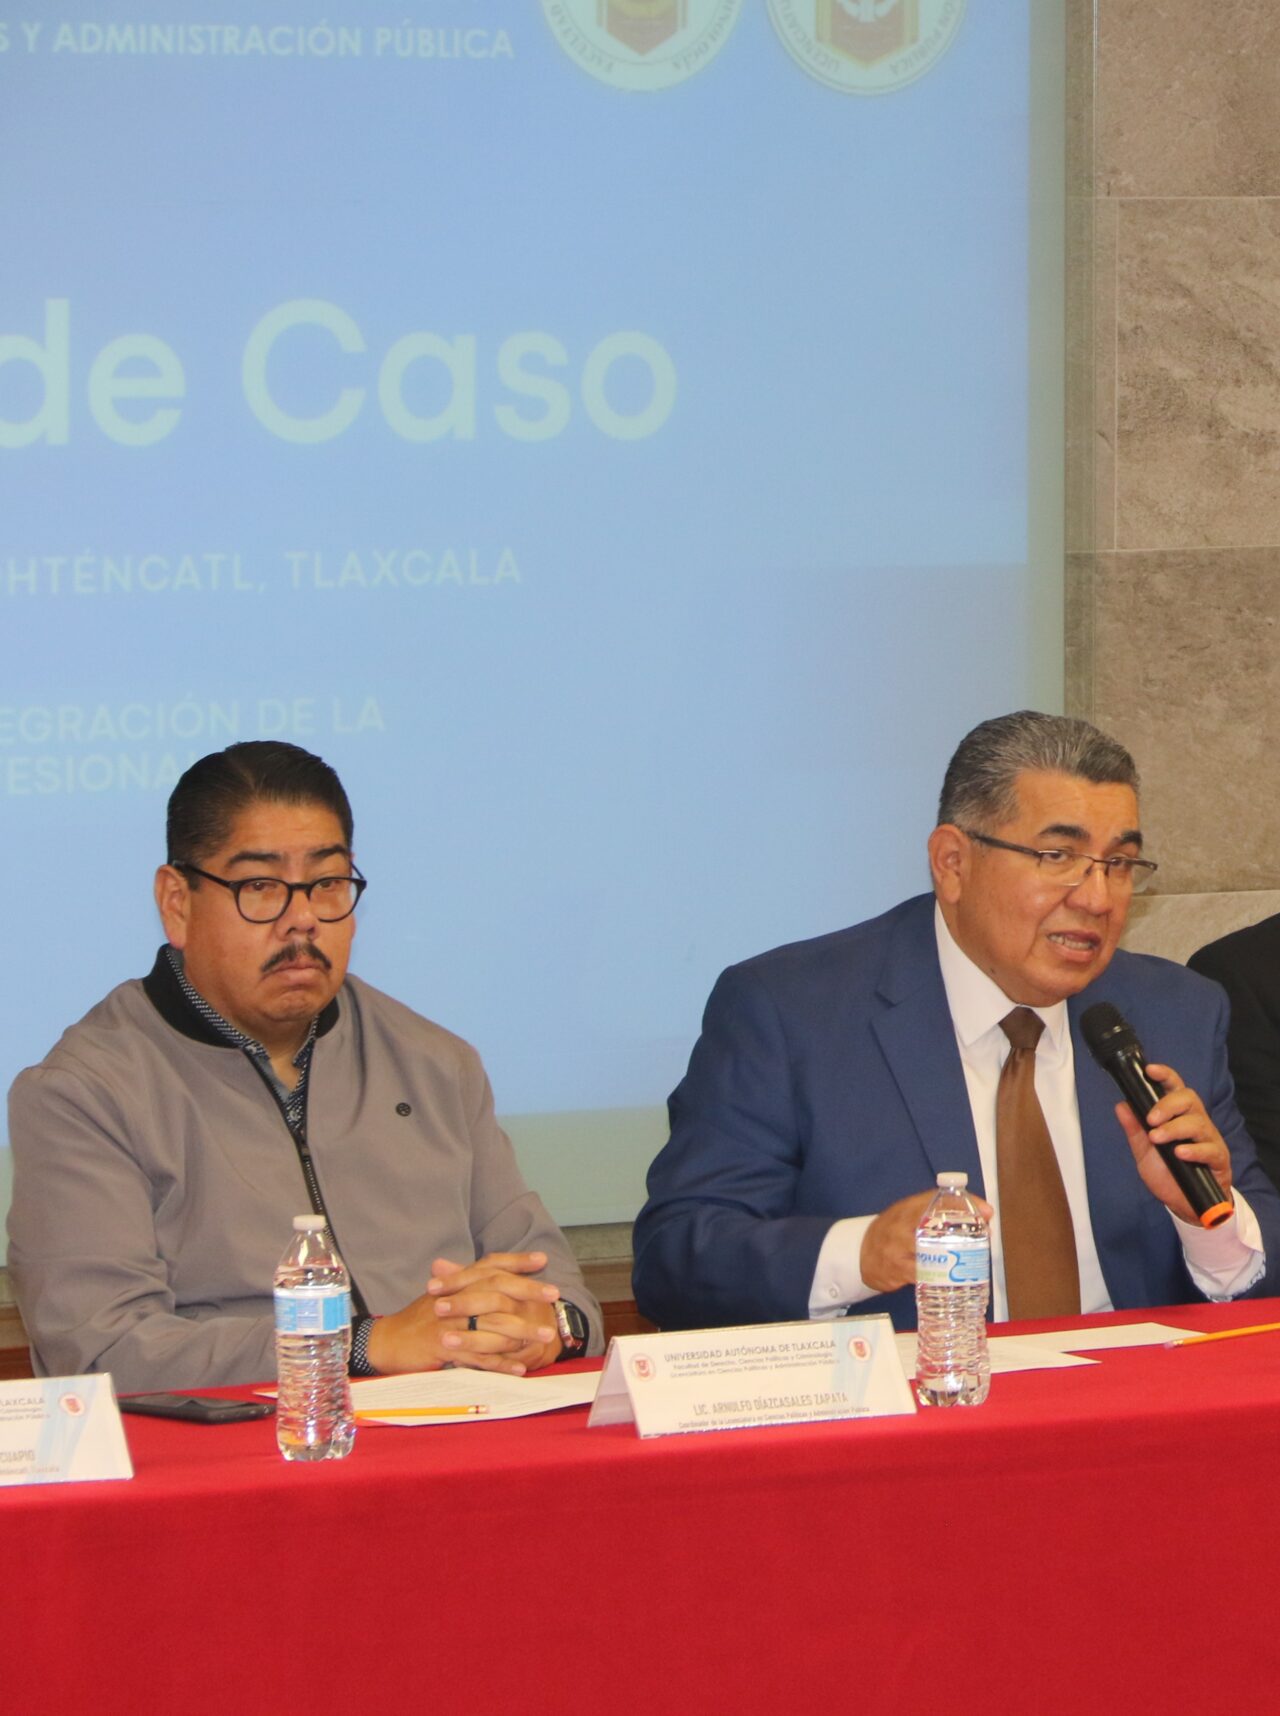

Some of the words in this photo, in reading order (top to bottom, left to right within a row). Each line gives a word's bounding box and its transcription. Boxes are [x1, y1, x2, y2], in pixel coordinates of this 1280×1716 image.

[21, 22, 41, 53] Y
[53, 18, 361, 56] ADMINISTRACIÓN
[375, 18, 515, 59] PÚBLICA
[0, 298, 186, 448] de
[242, 297, 678, 445] Caso
[285, 547, 521, 589] TLAXCALA
[257, 698, 317, 736] DE
[333, 696, 385, 732] LA
[8, 751, 198, 795] ESIONA
[664, 1350, 722, 1362] UNIVERSIDAD
[779, 1343, 791, 1353] DE
[792, 1340, 836, 1351] TLAXCALA
[814, 1392, 848, 1406] ZAPATA
